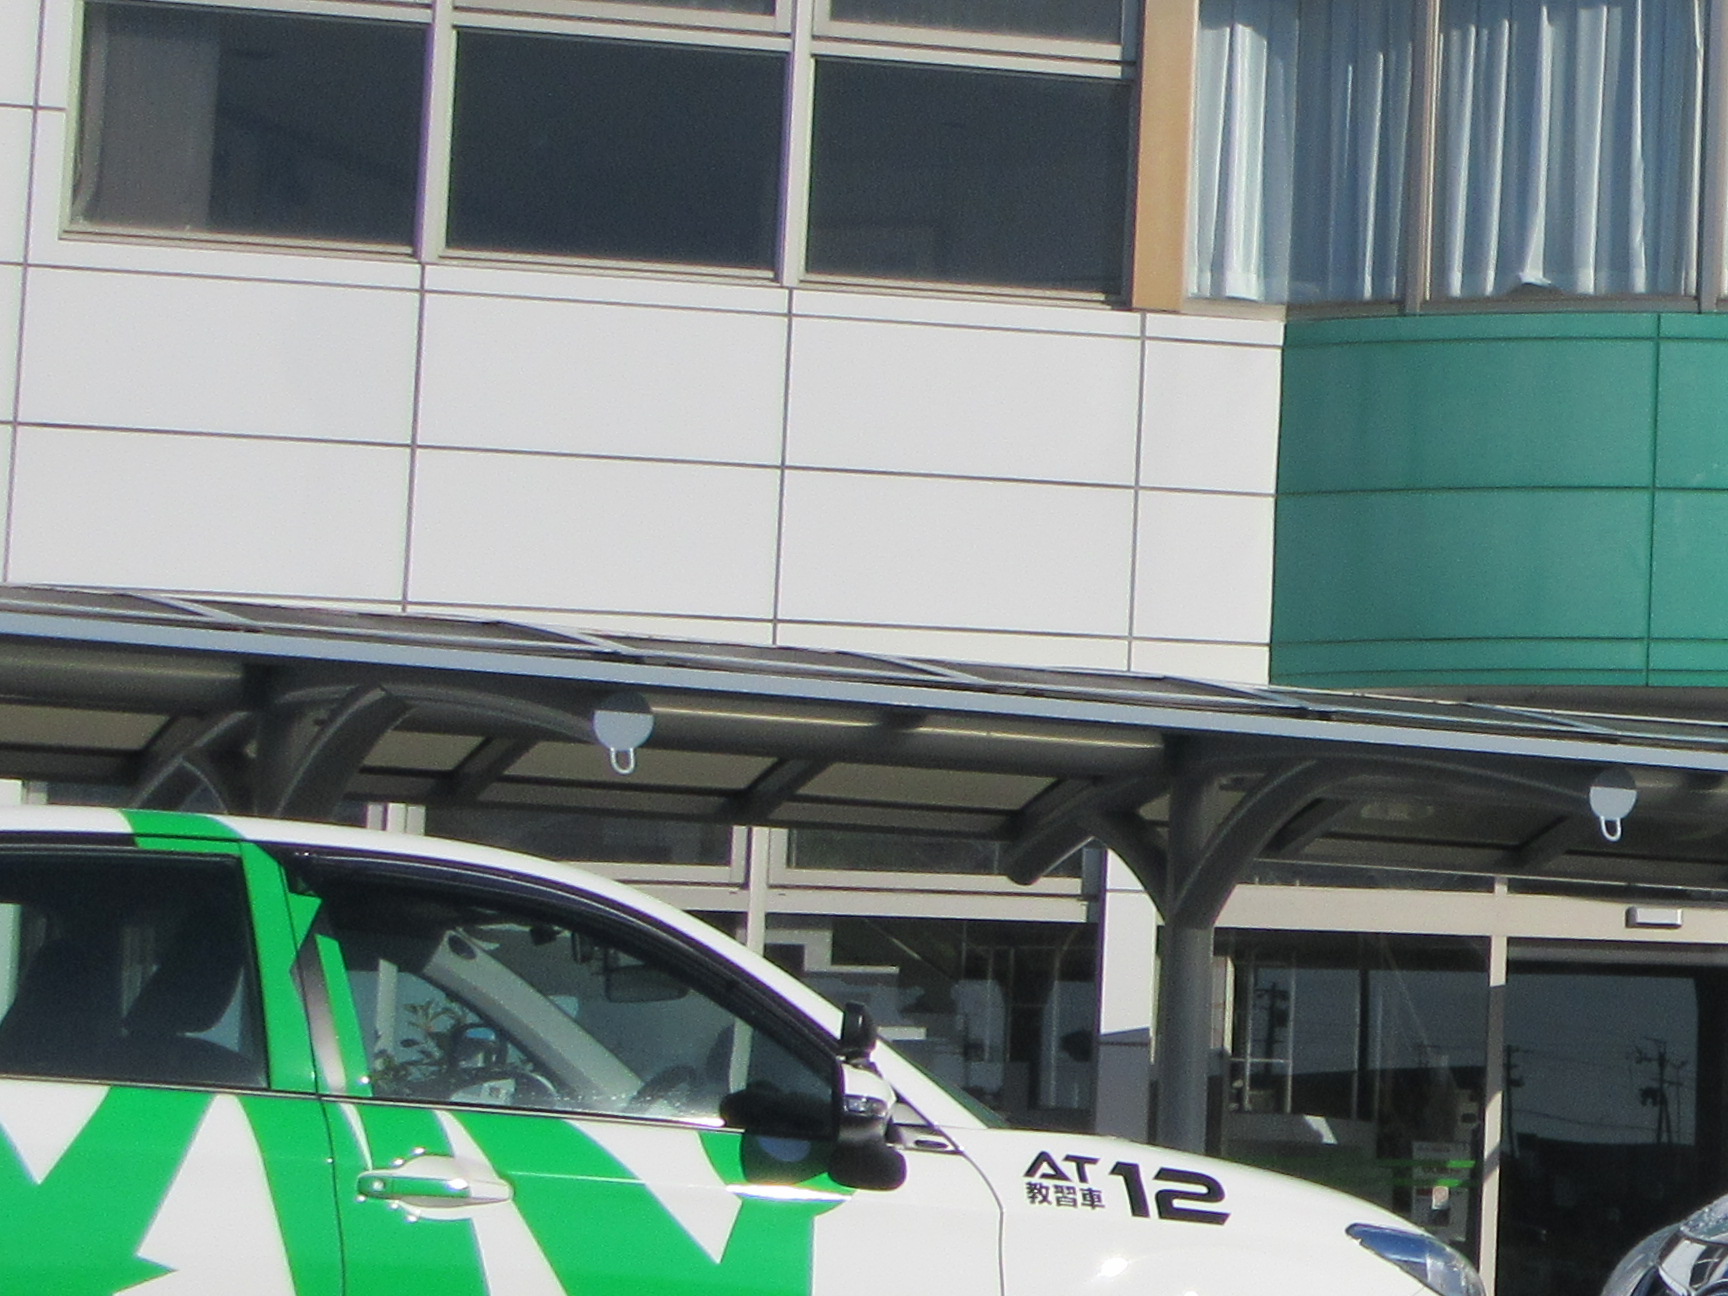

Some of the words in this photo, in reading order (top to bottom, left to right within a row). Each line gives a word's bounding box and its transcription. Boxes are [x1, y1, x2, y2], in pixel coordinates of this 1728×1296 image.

[1023, 1150, 1100, 1184] AT
[1109, 1160, 1231, 1226] 12
[1024, 1180, 1106, 1211] 教習車
